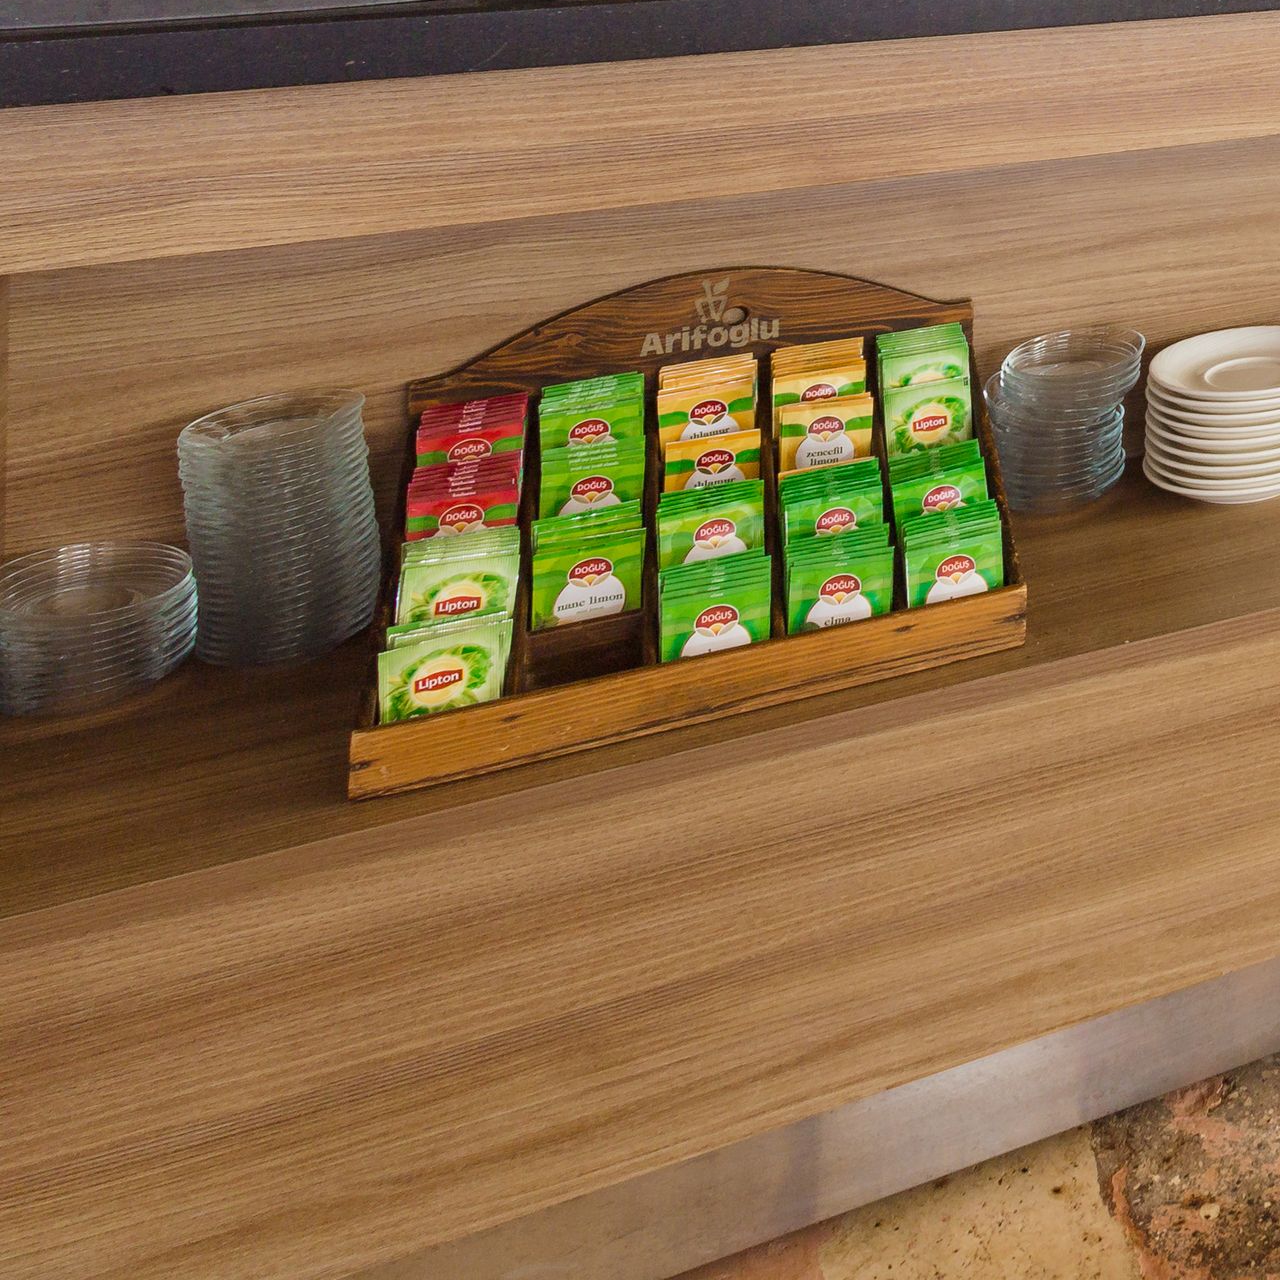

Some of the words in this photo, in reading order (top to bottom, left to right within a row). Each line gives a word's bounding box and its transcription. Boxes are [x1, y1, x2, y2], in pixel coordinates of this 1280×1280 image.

[805, 387, 834, 399] DOĞUŞ
[694, 403, 722, 416] DOĞUŞ
[574, 423, 604, 436] DOĞUŞ
[812, 420, 840, 431] DOĞUŞ
[915, 417, 945, 431] Lipton
[453, 443, 486, 456] DOĞUŞ
[806, 446, 843, 458] zencefil
[701, 454, 729, 465] DOĞUŞ
[810, 457, 839, 467] limon
[577, 480, 608, 493] DOĞUŞ
[928, 490, 956, 504] DOĞUŞ
[445, 510, 478, 523] DOĞUŞ
[821, 513, 850, 526] DOĞUŞ
[700, 523, 730, 537] DOĞUŞ
[574, 562, 607, 575] DOĞUŞ
[941, 559, 970, 574] DOĞUŞ
[825, 579, 855, 592] DOĞUŞ
[589, 592, 624, 605] limon
[438, 598, 478, 614] Lipton
[701, 610, 733, 624] DOĞUŞ
[418, 672, 460, 691] Lipton
